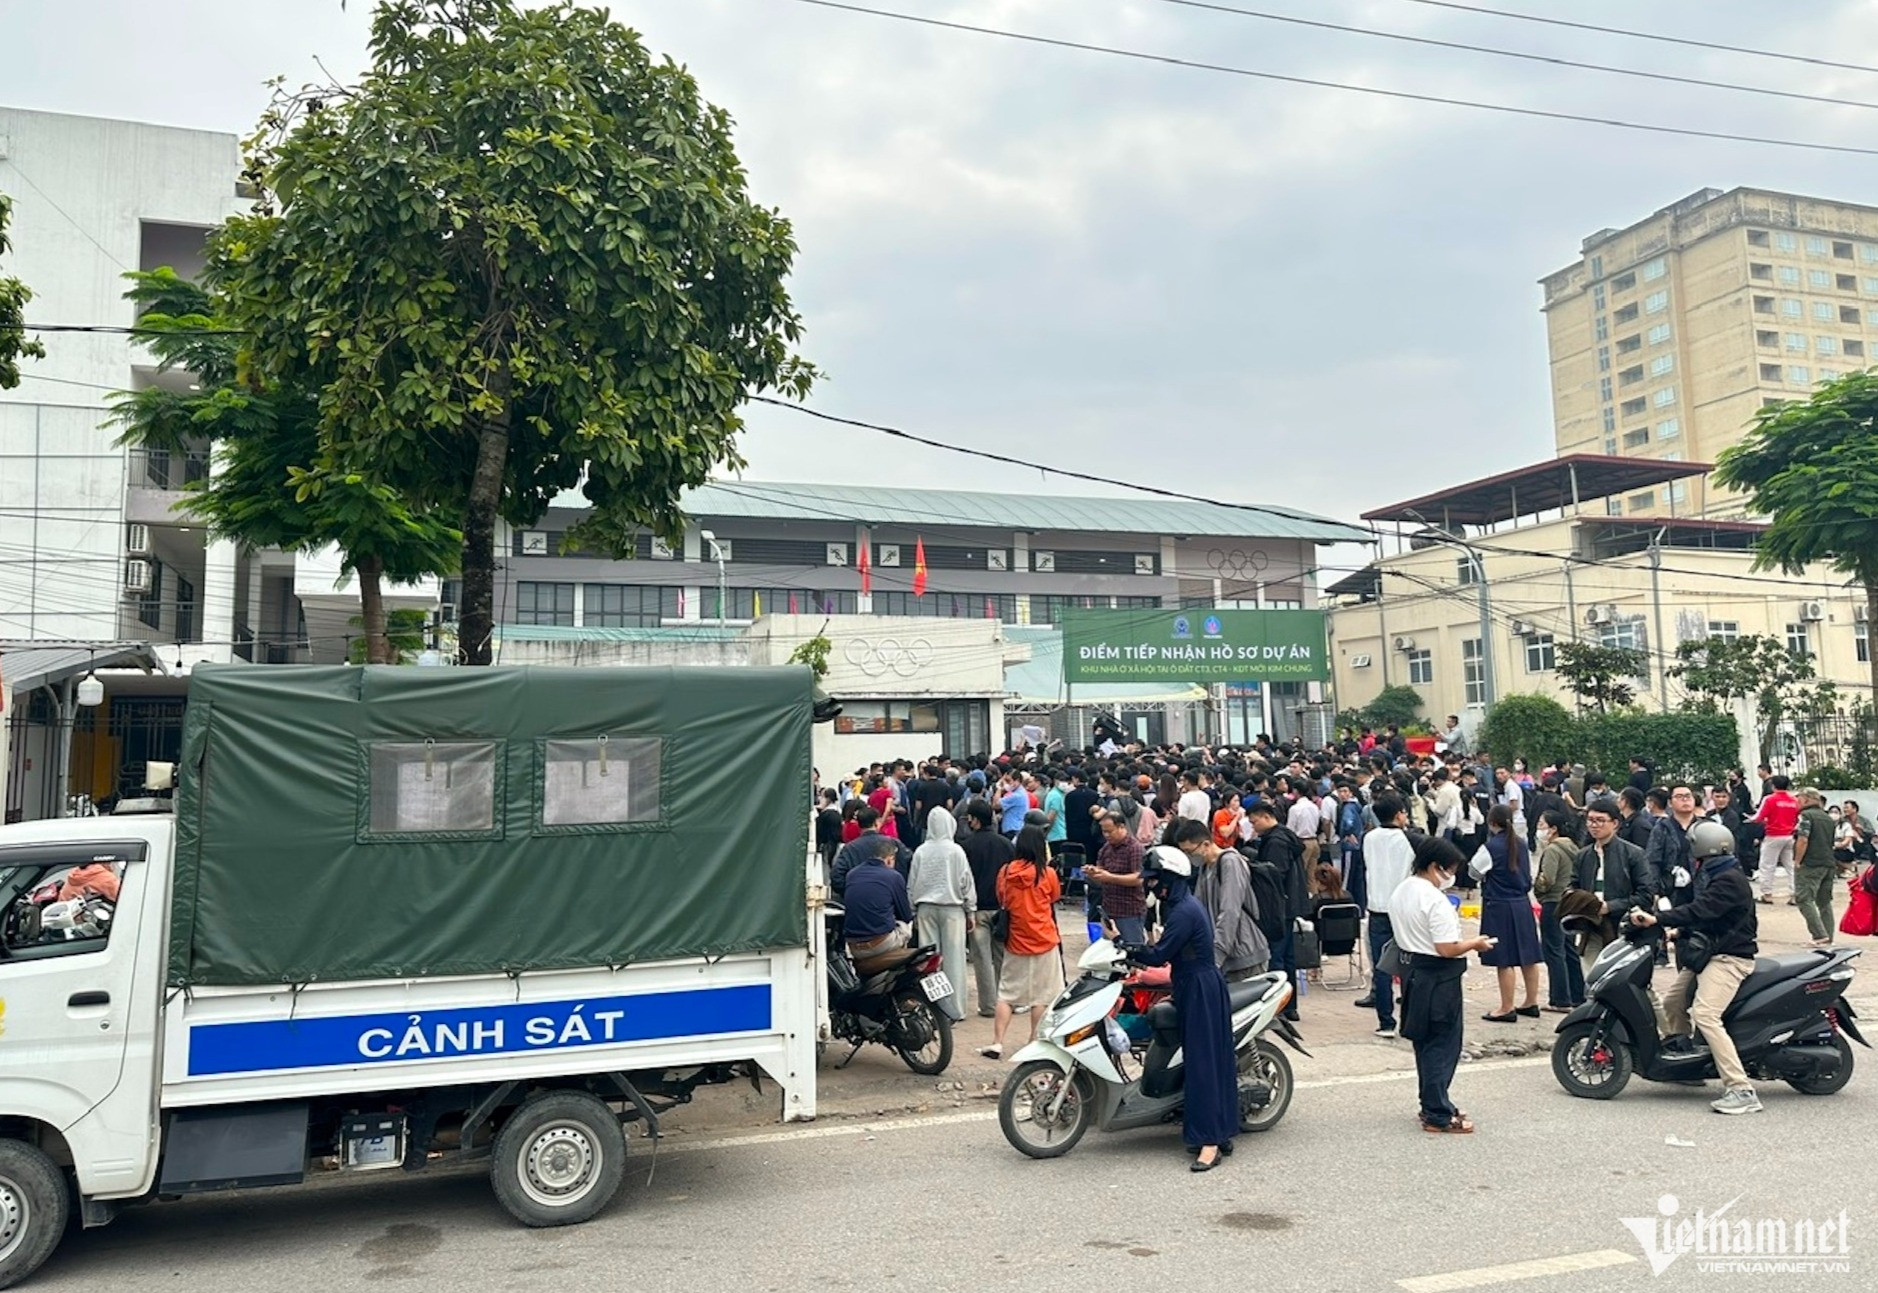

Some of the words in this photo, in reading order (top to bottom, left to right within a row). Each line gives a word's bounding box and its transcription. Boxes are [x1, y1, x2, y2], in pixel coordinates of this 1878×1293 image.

[1124, 643, 1157, 660] TIẾP
[1161, 644, 1206, 662] NHẬN
[1211, 643, 1233, 659] HỒ
[1237, 646, 1258, 659] SƠ
[1263, 646, 1287, 661] DỰ
[1289, 643, 1310, 659] ÁN
[1081, 664, 1098, 673] KHU
[1100, 664, 1119, 673] NHÀ
[1140, 664, 1156, 674] HỘI
[1212, 664, 1227, 673] CT4
[1250, 663, 1267, 673] MỚI
[1268, 664, 1283, 673] KIM
[1283, 663, 1313, 673] CHUNG
[358, 1015, 504, 1057] CẢNH
[525, 1004, 624, 1045] SÁT
